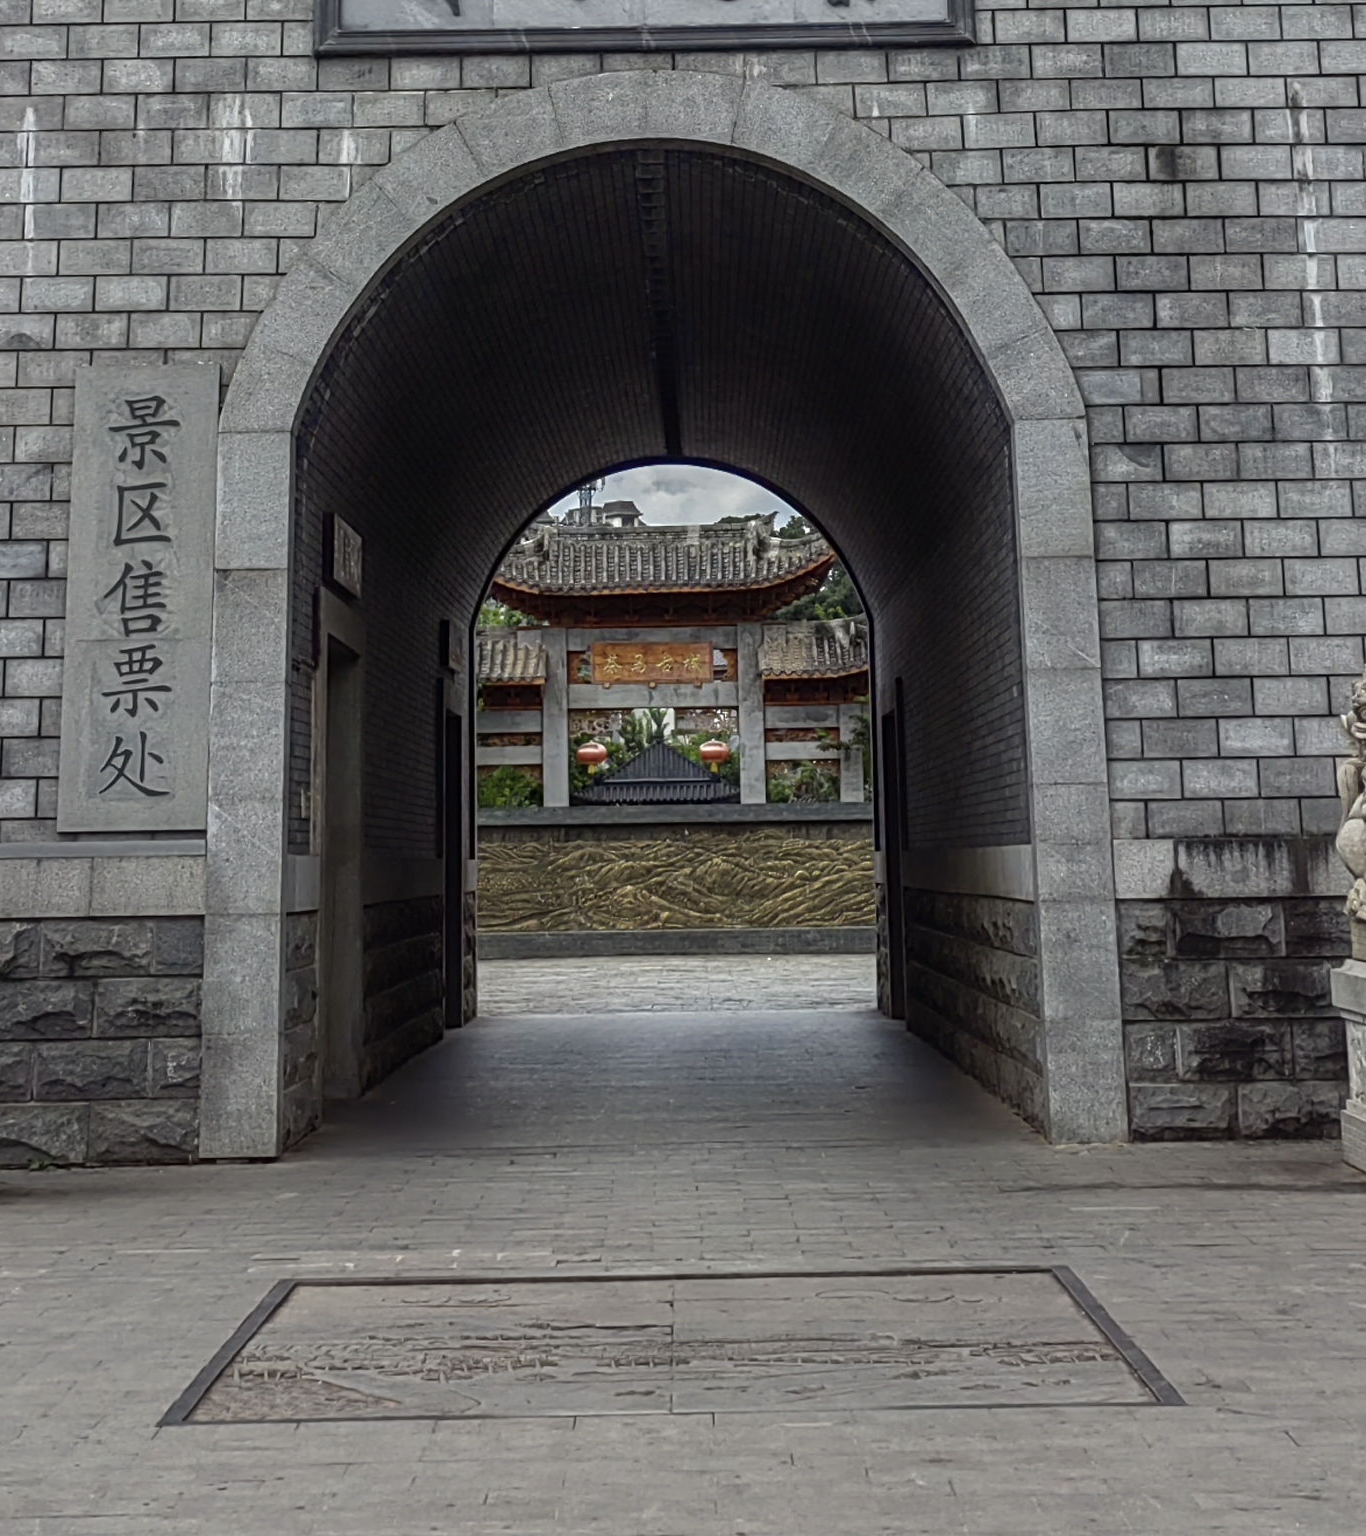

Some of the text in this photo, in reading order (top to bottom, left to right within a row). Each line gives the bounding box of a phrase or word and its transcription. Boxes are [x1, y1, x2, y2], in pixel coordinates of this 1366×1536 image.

[98, 394, 181, 798] 景区售票处
